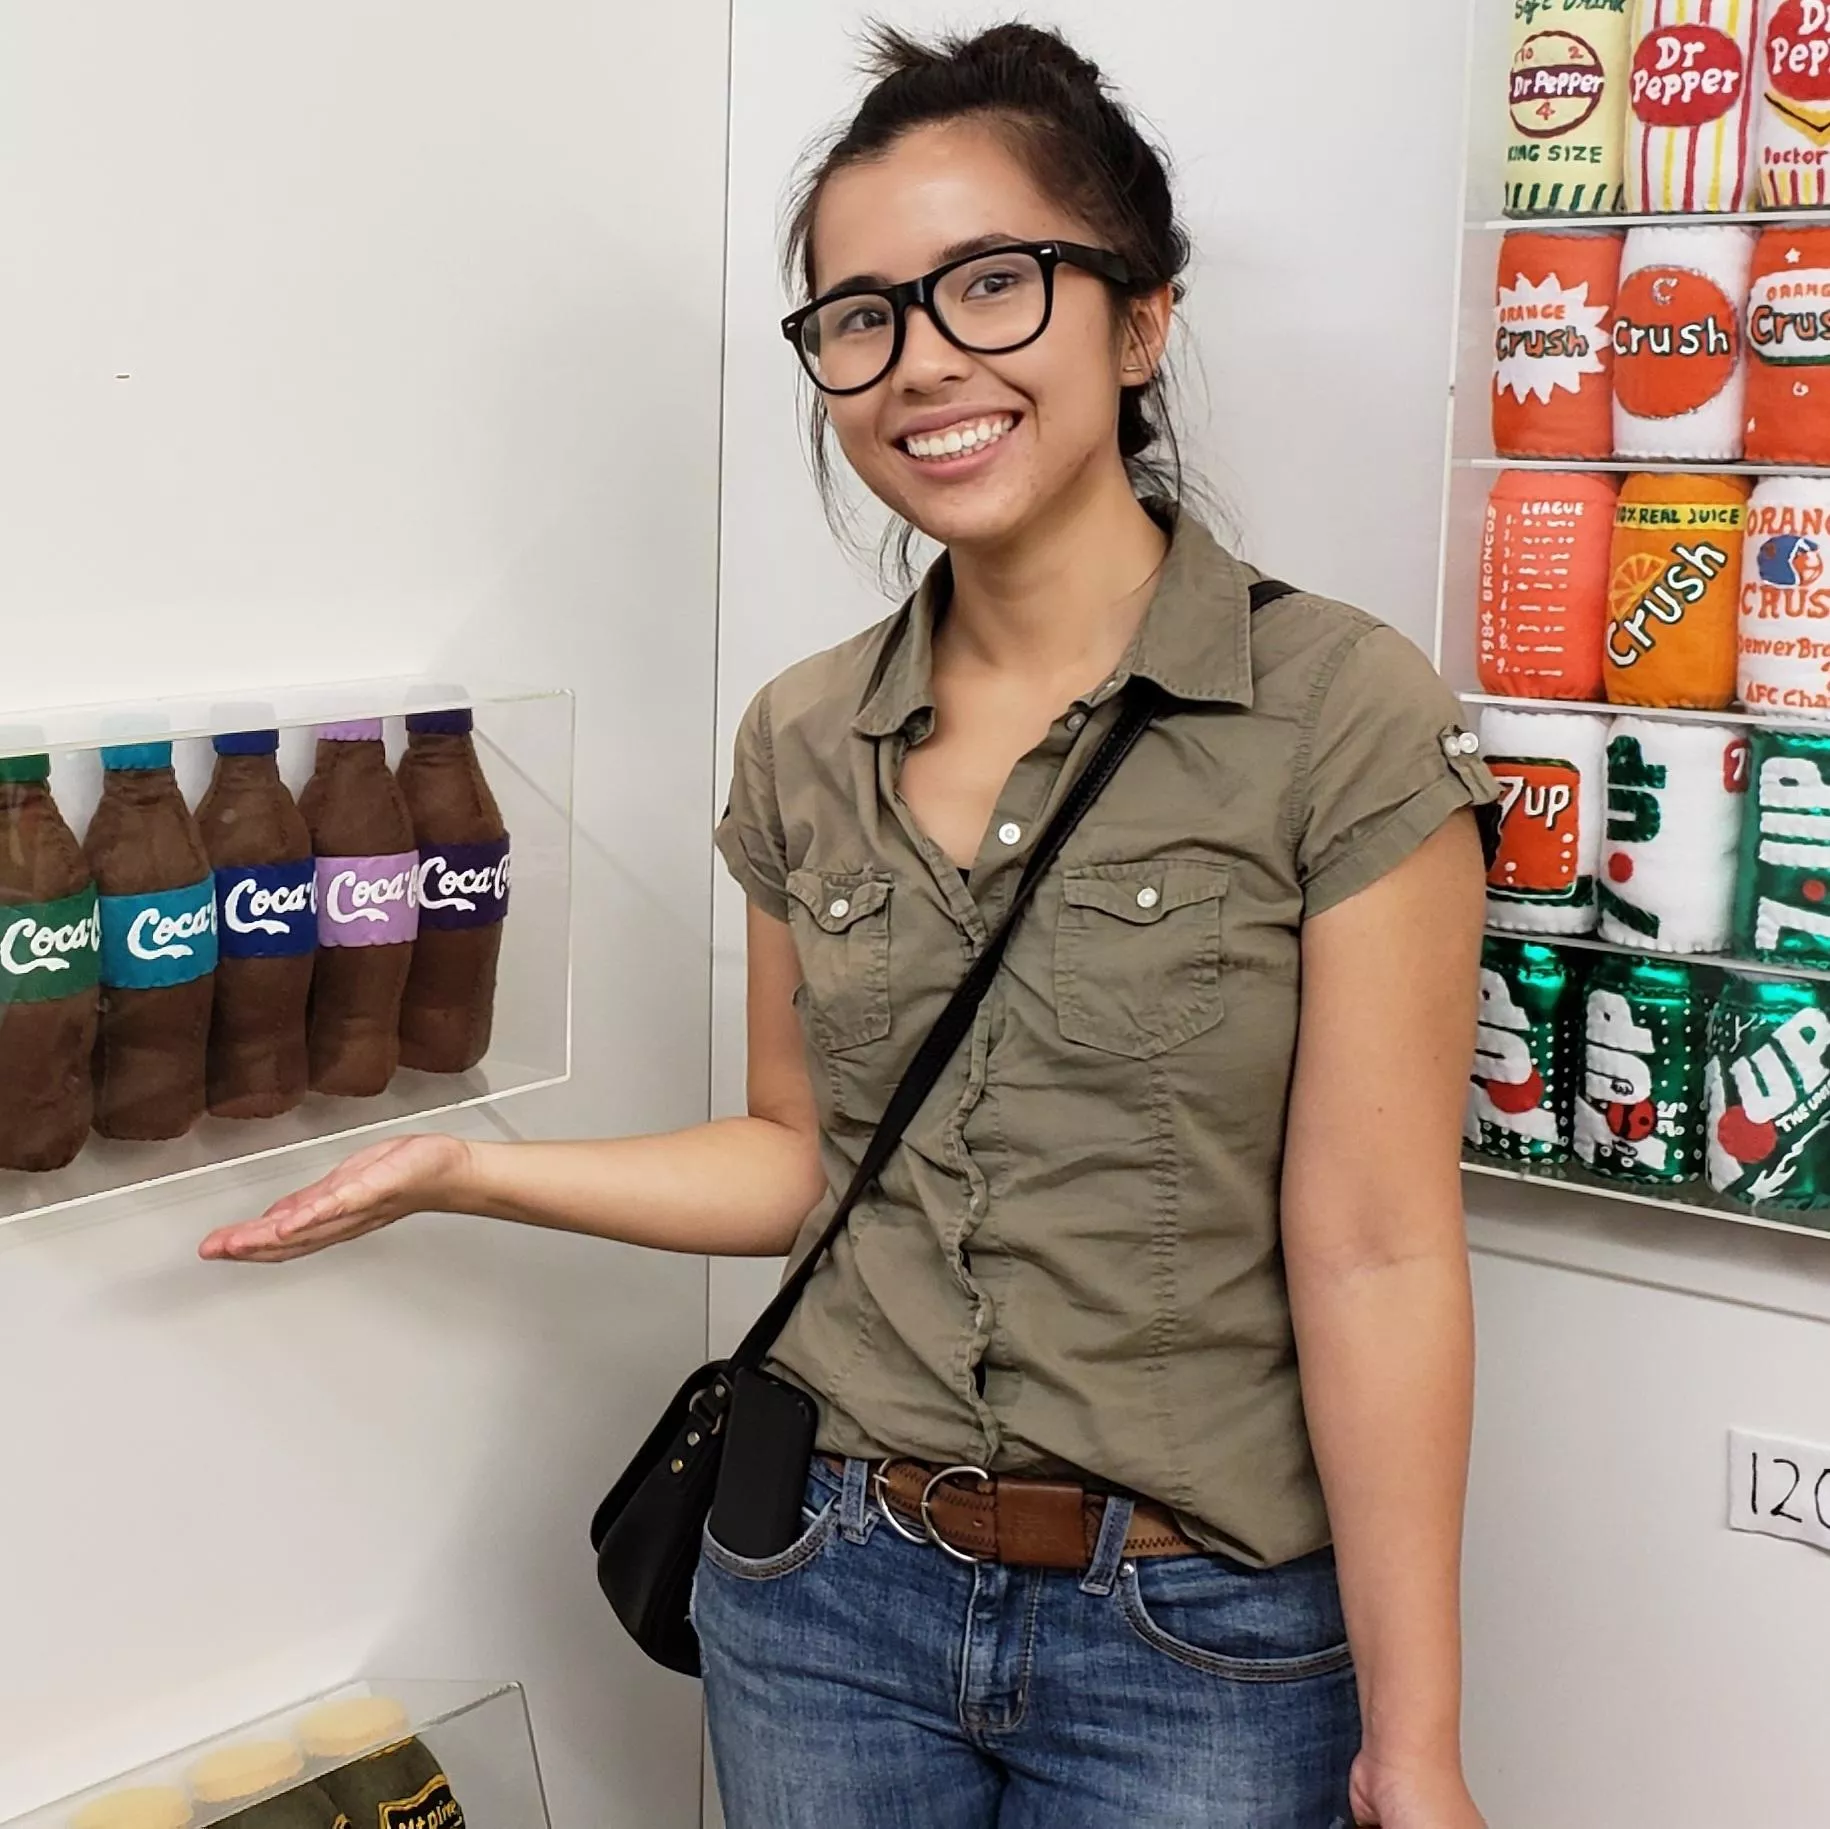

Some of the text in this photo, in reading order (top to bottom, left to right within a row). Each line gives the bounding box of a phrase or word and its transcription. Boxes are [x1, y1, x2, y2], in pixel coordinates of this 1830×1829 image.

[1568, 46, 1584, 59] 2
[1655, 36, 1706, 70] Dr
[1513, 70, 1605, 97] Dr Pepper
[1632, 67, 1740, 105] Pepper
[1536, 102, 1556, 121] 4
[1548, 145, 1603, 163] SIZE
[1499, 303, 1566, 323] ORANGE
[1496, 325, 1590, 362] Crush
[1613, 315, 1730, 357] Crush
[1521, 501, 1584, 516] LEAGUE
[1639, 508, 1681, 524] REAL
[1687, 508, 1740, 525] JUICE
[1746, 506, 1830, 536] ORAN
[1481, 506, 1497, 664] 1984 BRONCOS
[1605, 541, 1729, 670] Crush
[1746, 681, 1780, 706] AFC
[1731, 747, 1747, 781] 7
[1775, 1103, 1810, 1133] THE
